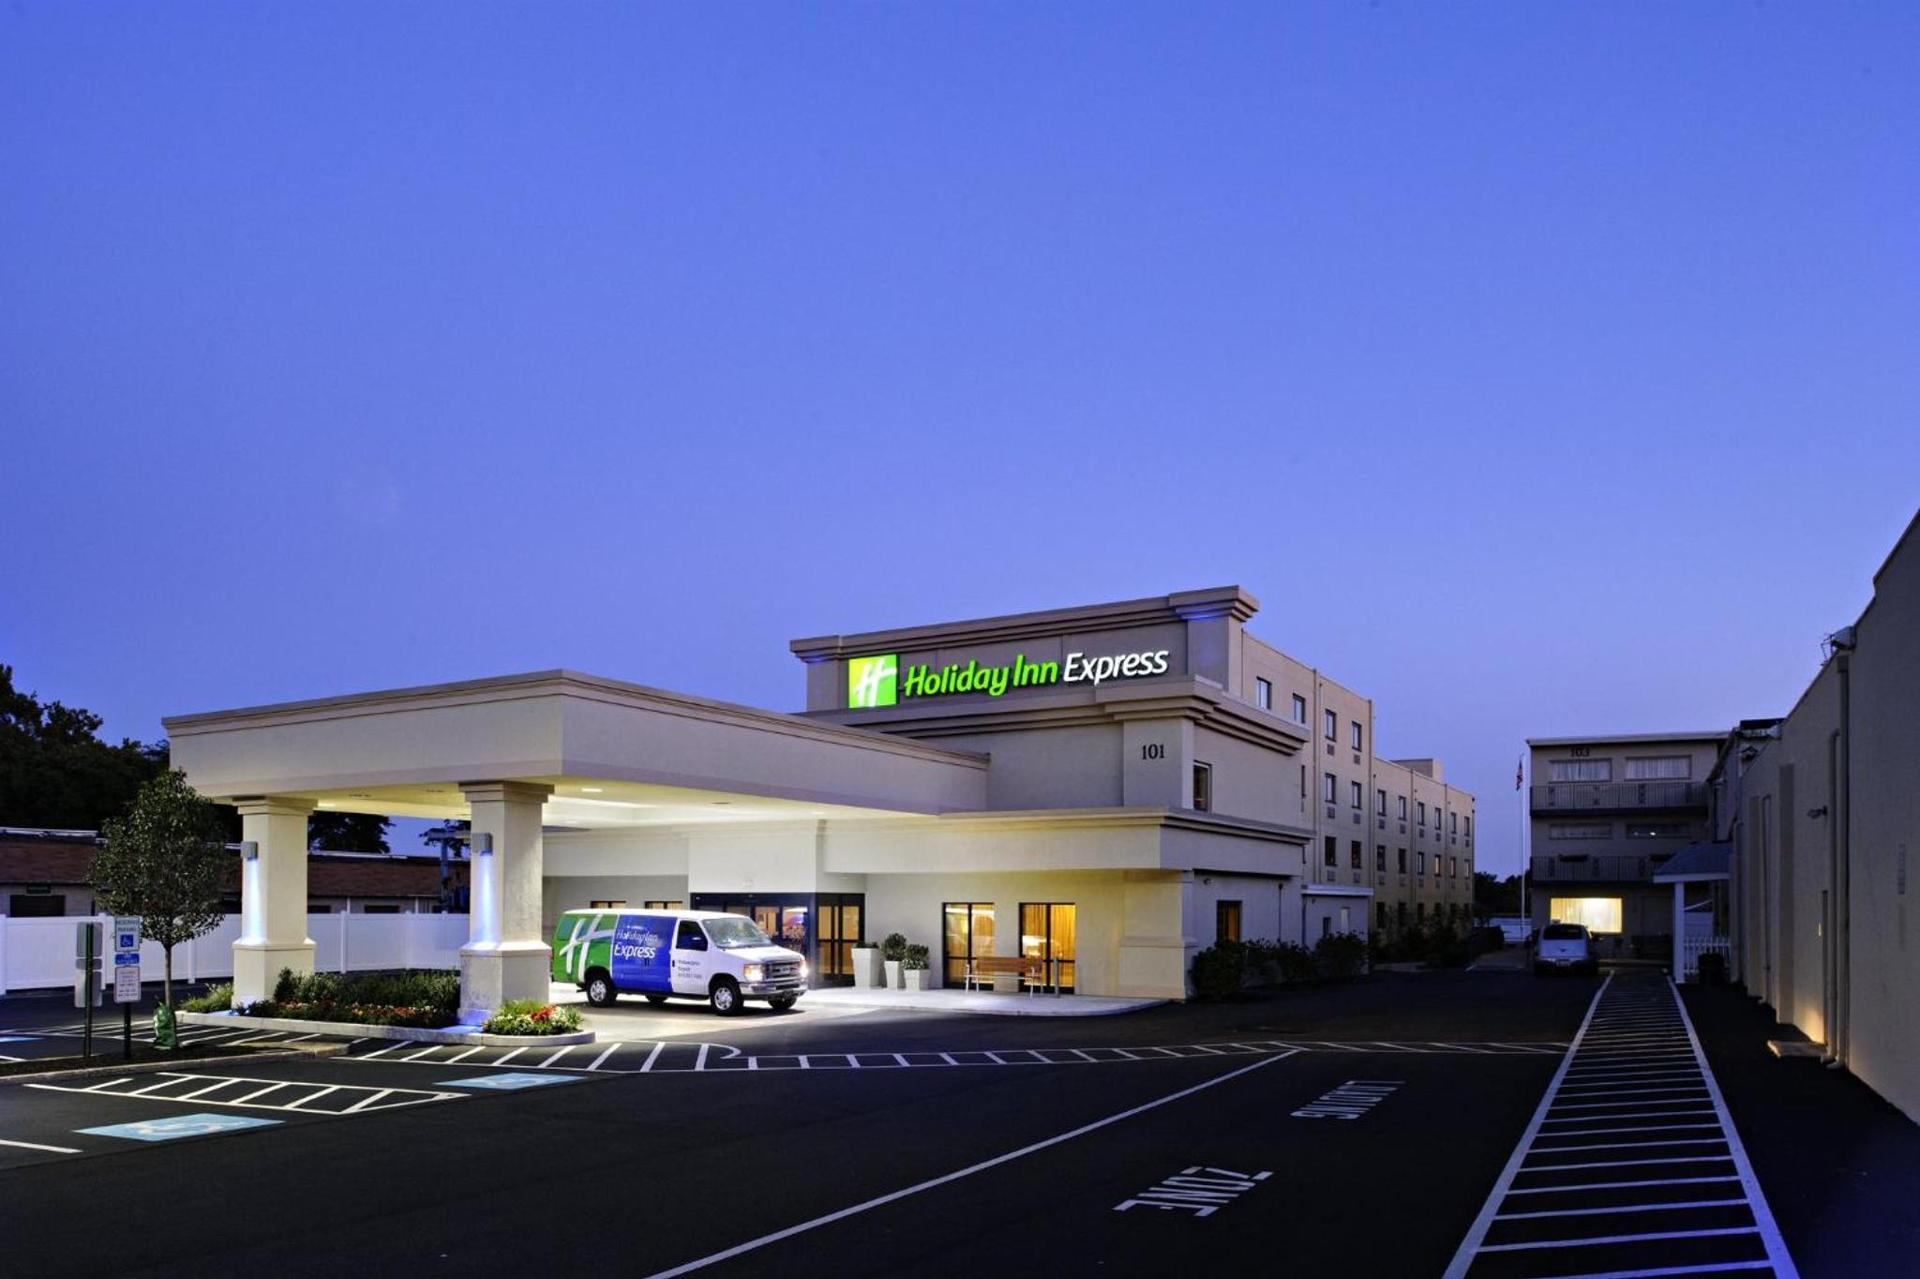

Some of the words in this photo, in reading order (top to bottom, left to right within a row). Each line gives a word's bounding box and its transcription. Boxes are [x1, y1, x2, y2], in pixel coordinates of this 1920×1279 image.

[904, 658, 1009, 697] Holiday
[1013, 654, 1058, 687] Inn
[1063, 650, 1169, 686] Express
[1142, 743, 1165, 760] 101
[616, 928, 646, 945] Holiday
[613, 941, 657, 960] Express
[1112, 1166, 1274, 1217] ZONE
